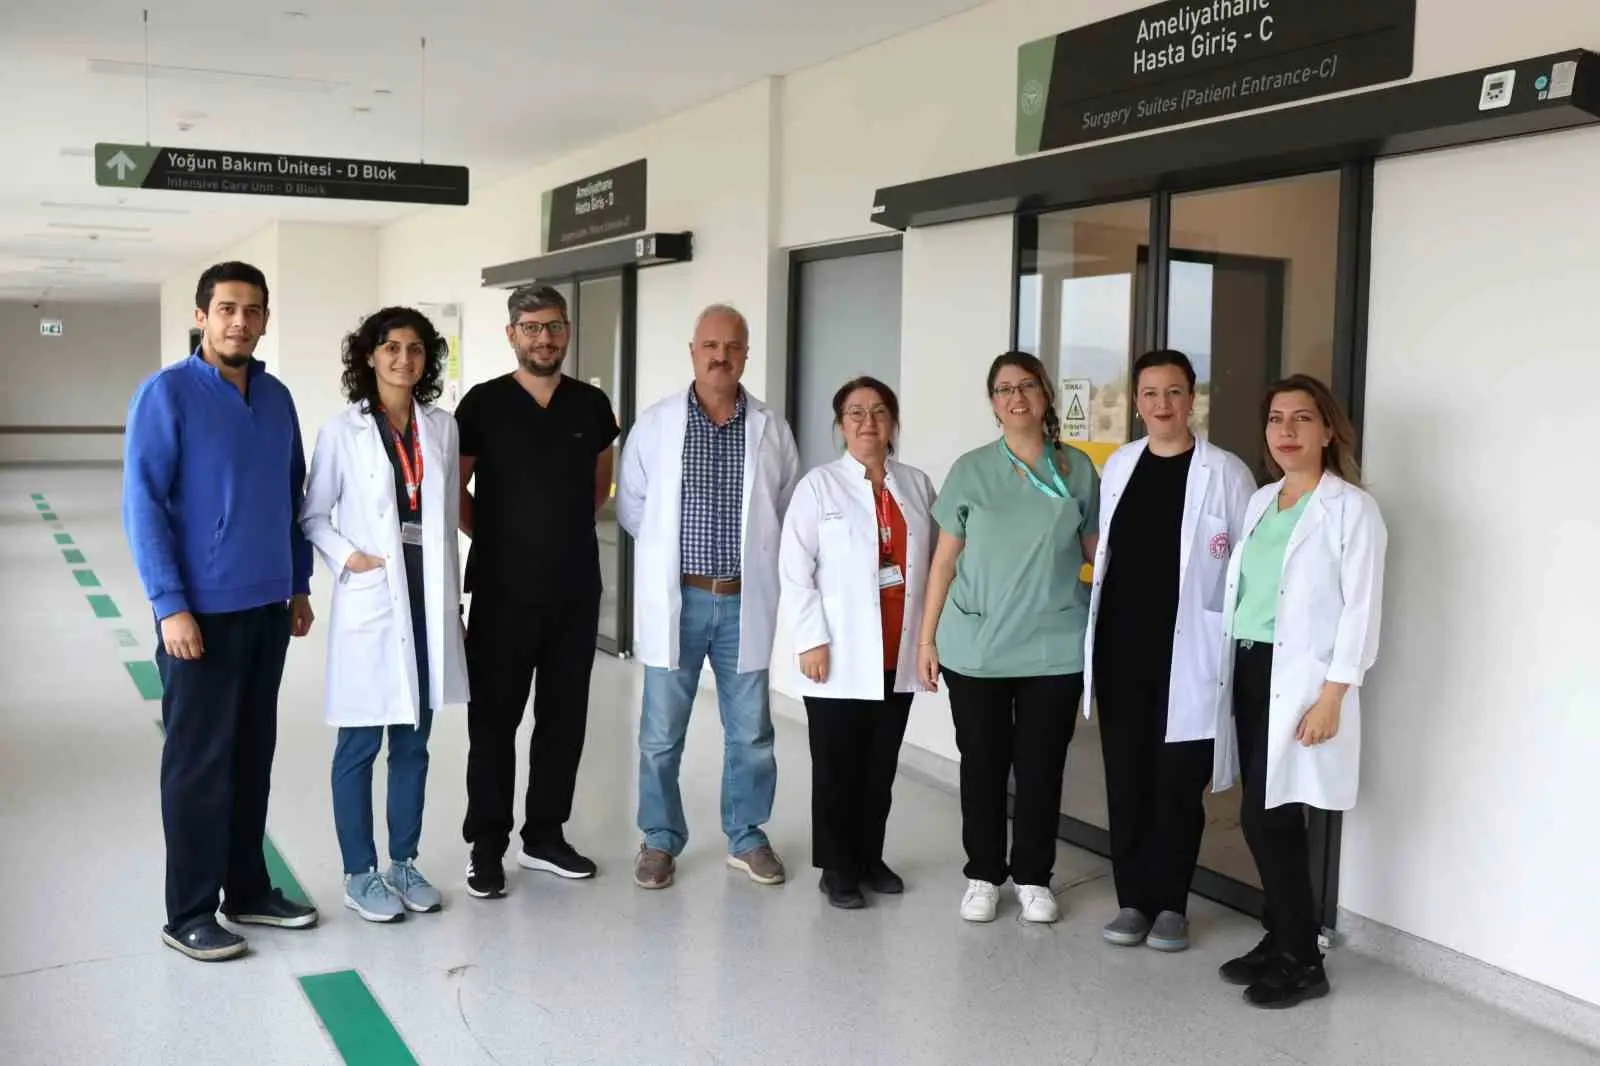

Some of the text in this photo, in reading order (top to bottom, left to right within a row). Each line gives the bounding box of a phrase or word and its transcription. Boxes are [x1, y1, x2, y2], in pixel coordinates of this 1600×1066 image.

[1132, 43, 1185, 74] Hasta
[1191, 27, 1238, 58] Giriş
[1259, 15, 1274, 41] C
[1080, 54, 1338, 130] Surgery Suites (Patient Entrance-C)
[168, 152, 217, 172] Yoğun
[222, 156, 273, 173] Bakım
[278, 156, 331, 177] Ünitesi
[347, 164, 358, 177] D
[363, 164, 397, 180] Blok
